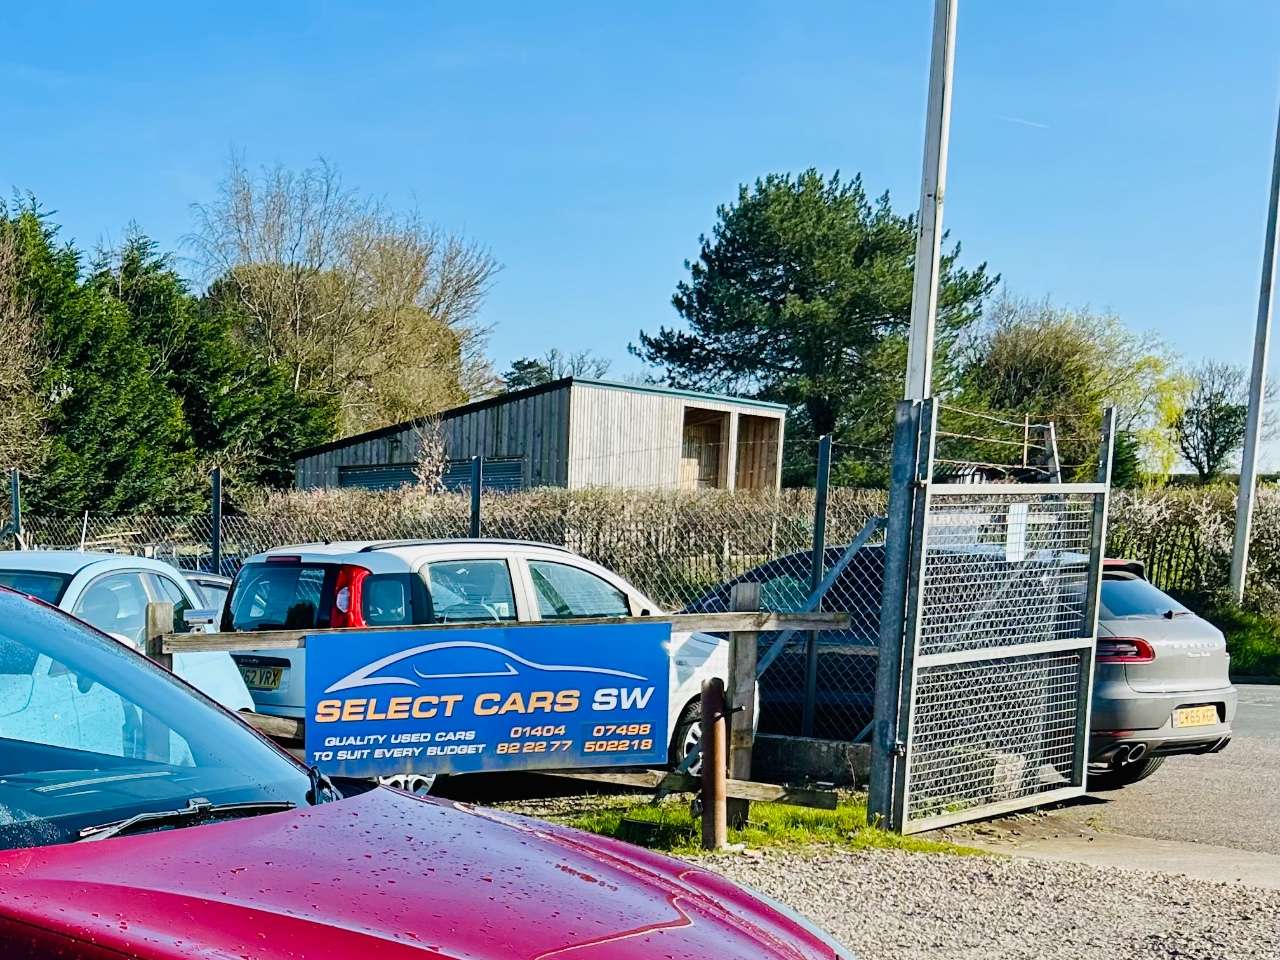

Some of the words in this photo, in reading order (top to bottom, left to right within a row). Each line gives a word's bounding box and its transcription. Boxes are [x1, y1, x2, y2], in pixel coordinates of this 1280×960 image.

[260, 671, 279, 687] VRX
[314, 694, 463, 723] SELECT
[473, 689, 581, 716] CARS
[592, 686, 656, 711] SW
[510, 725, 566, 738] 01404
[592, 723, 651, 737] 07498
[324, 734, 387, 747] QUALITY
[390, 733, 431, 744] USED
[435, 730, 476, 742] CARS
[583, 738, 653, 753] 502218
[313, 751, 333, 762] TO
[336, 749, 371, 760] SUIT
[373, 747, 424, 759] EVERY
[426, 743, 487, 756] BUDGET
[496, 743, 520, 754] 82
[522, 742, 547, 753] 22
[550, 740, 573, 752] 77
